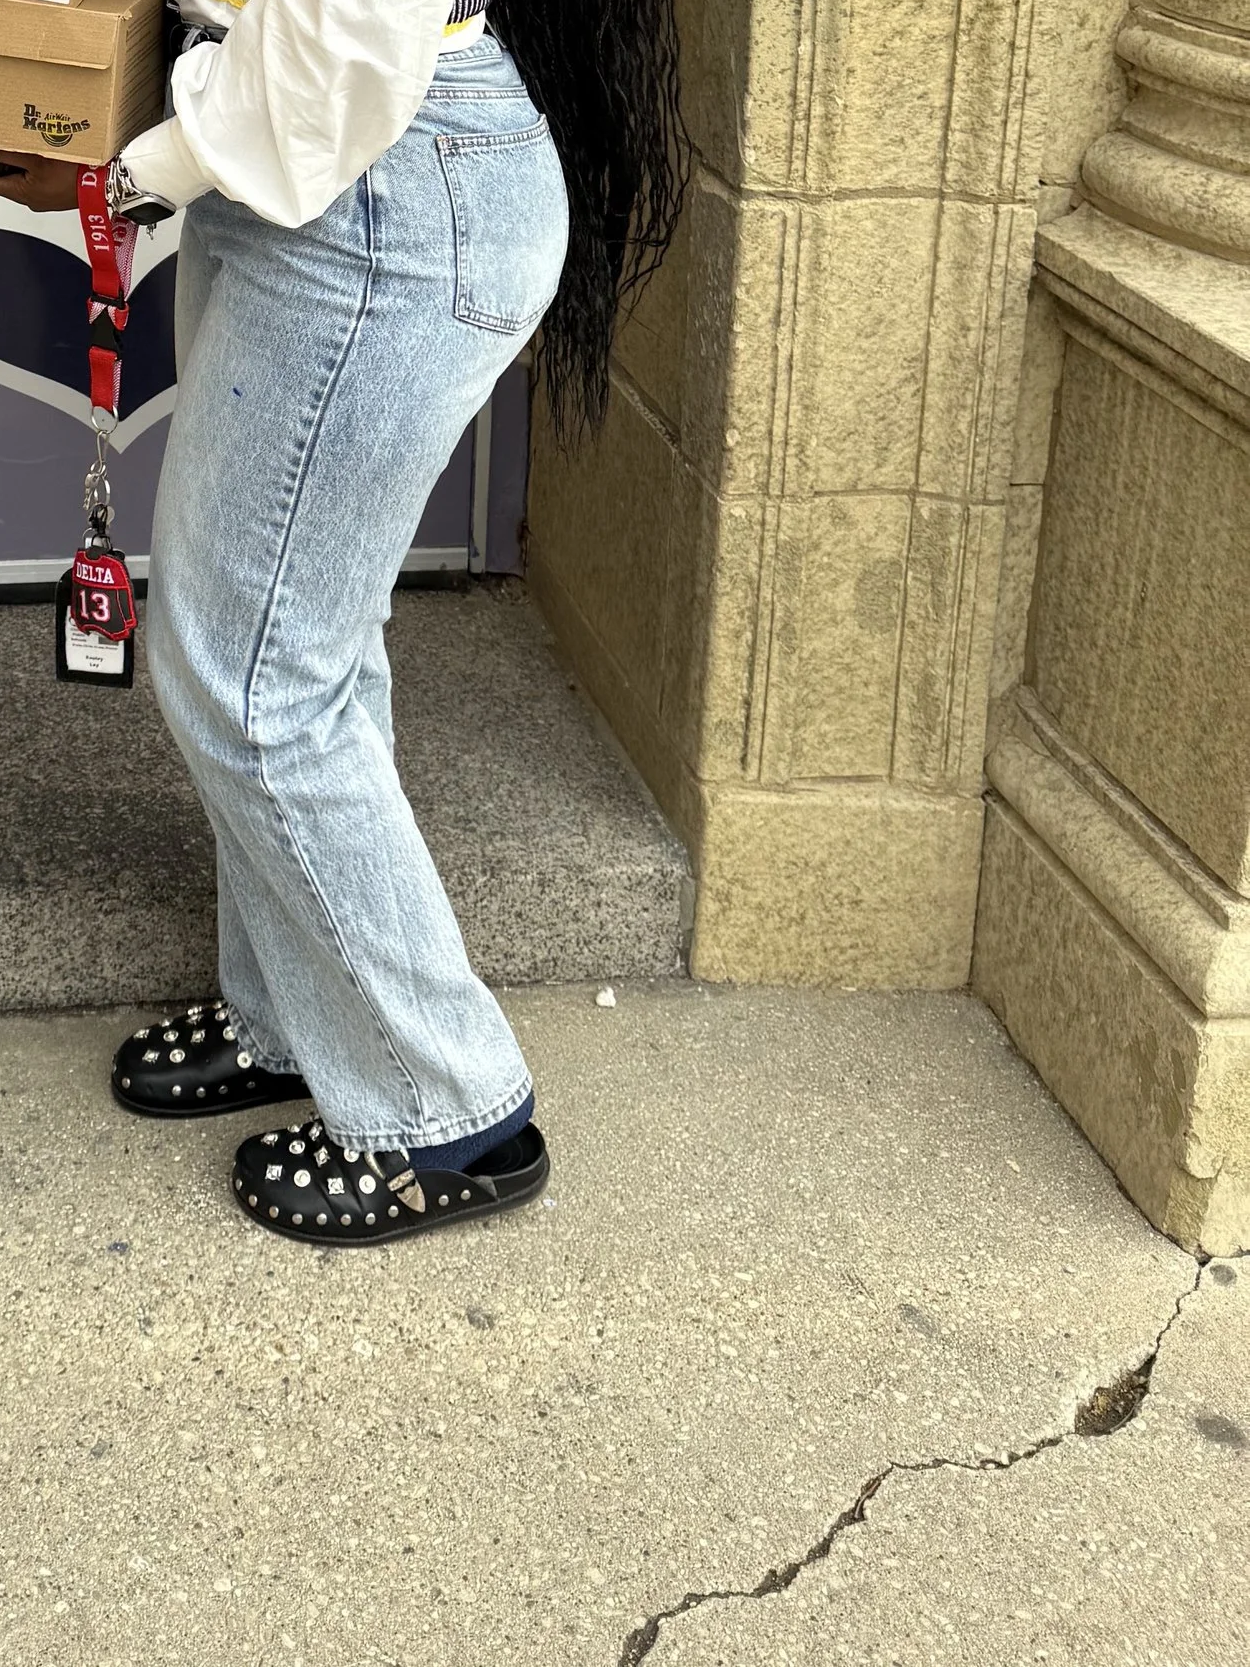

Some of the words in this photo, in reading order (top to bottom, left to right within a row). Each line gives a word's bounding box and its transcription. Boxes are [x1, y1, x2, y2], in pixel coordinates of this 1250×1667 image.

[24, 103, 41, 118] Dr.
[44, 112, 71, 122] AirWair
[22, 116, 91, 134] Martens
[88, 214, 110, 252] 1913
[76, 561, 115, 584] DELTA
[79, 589, 111, 622] 13
